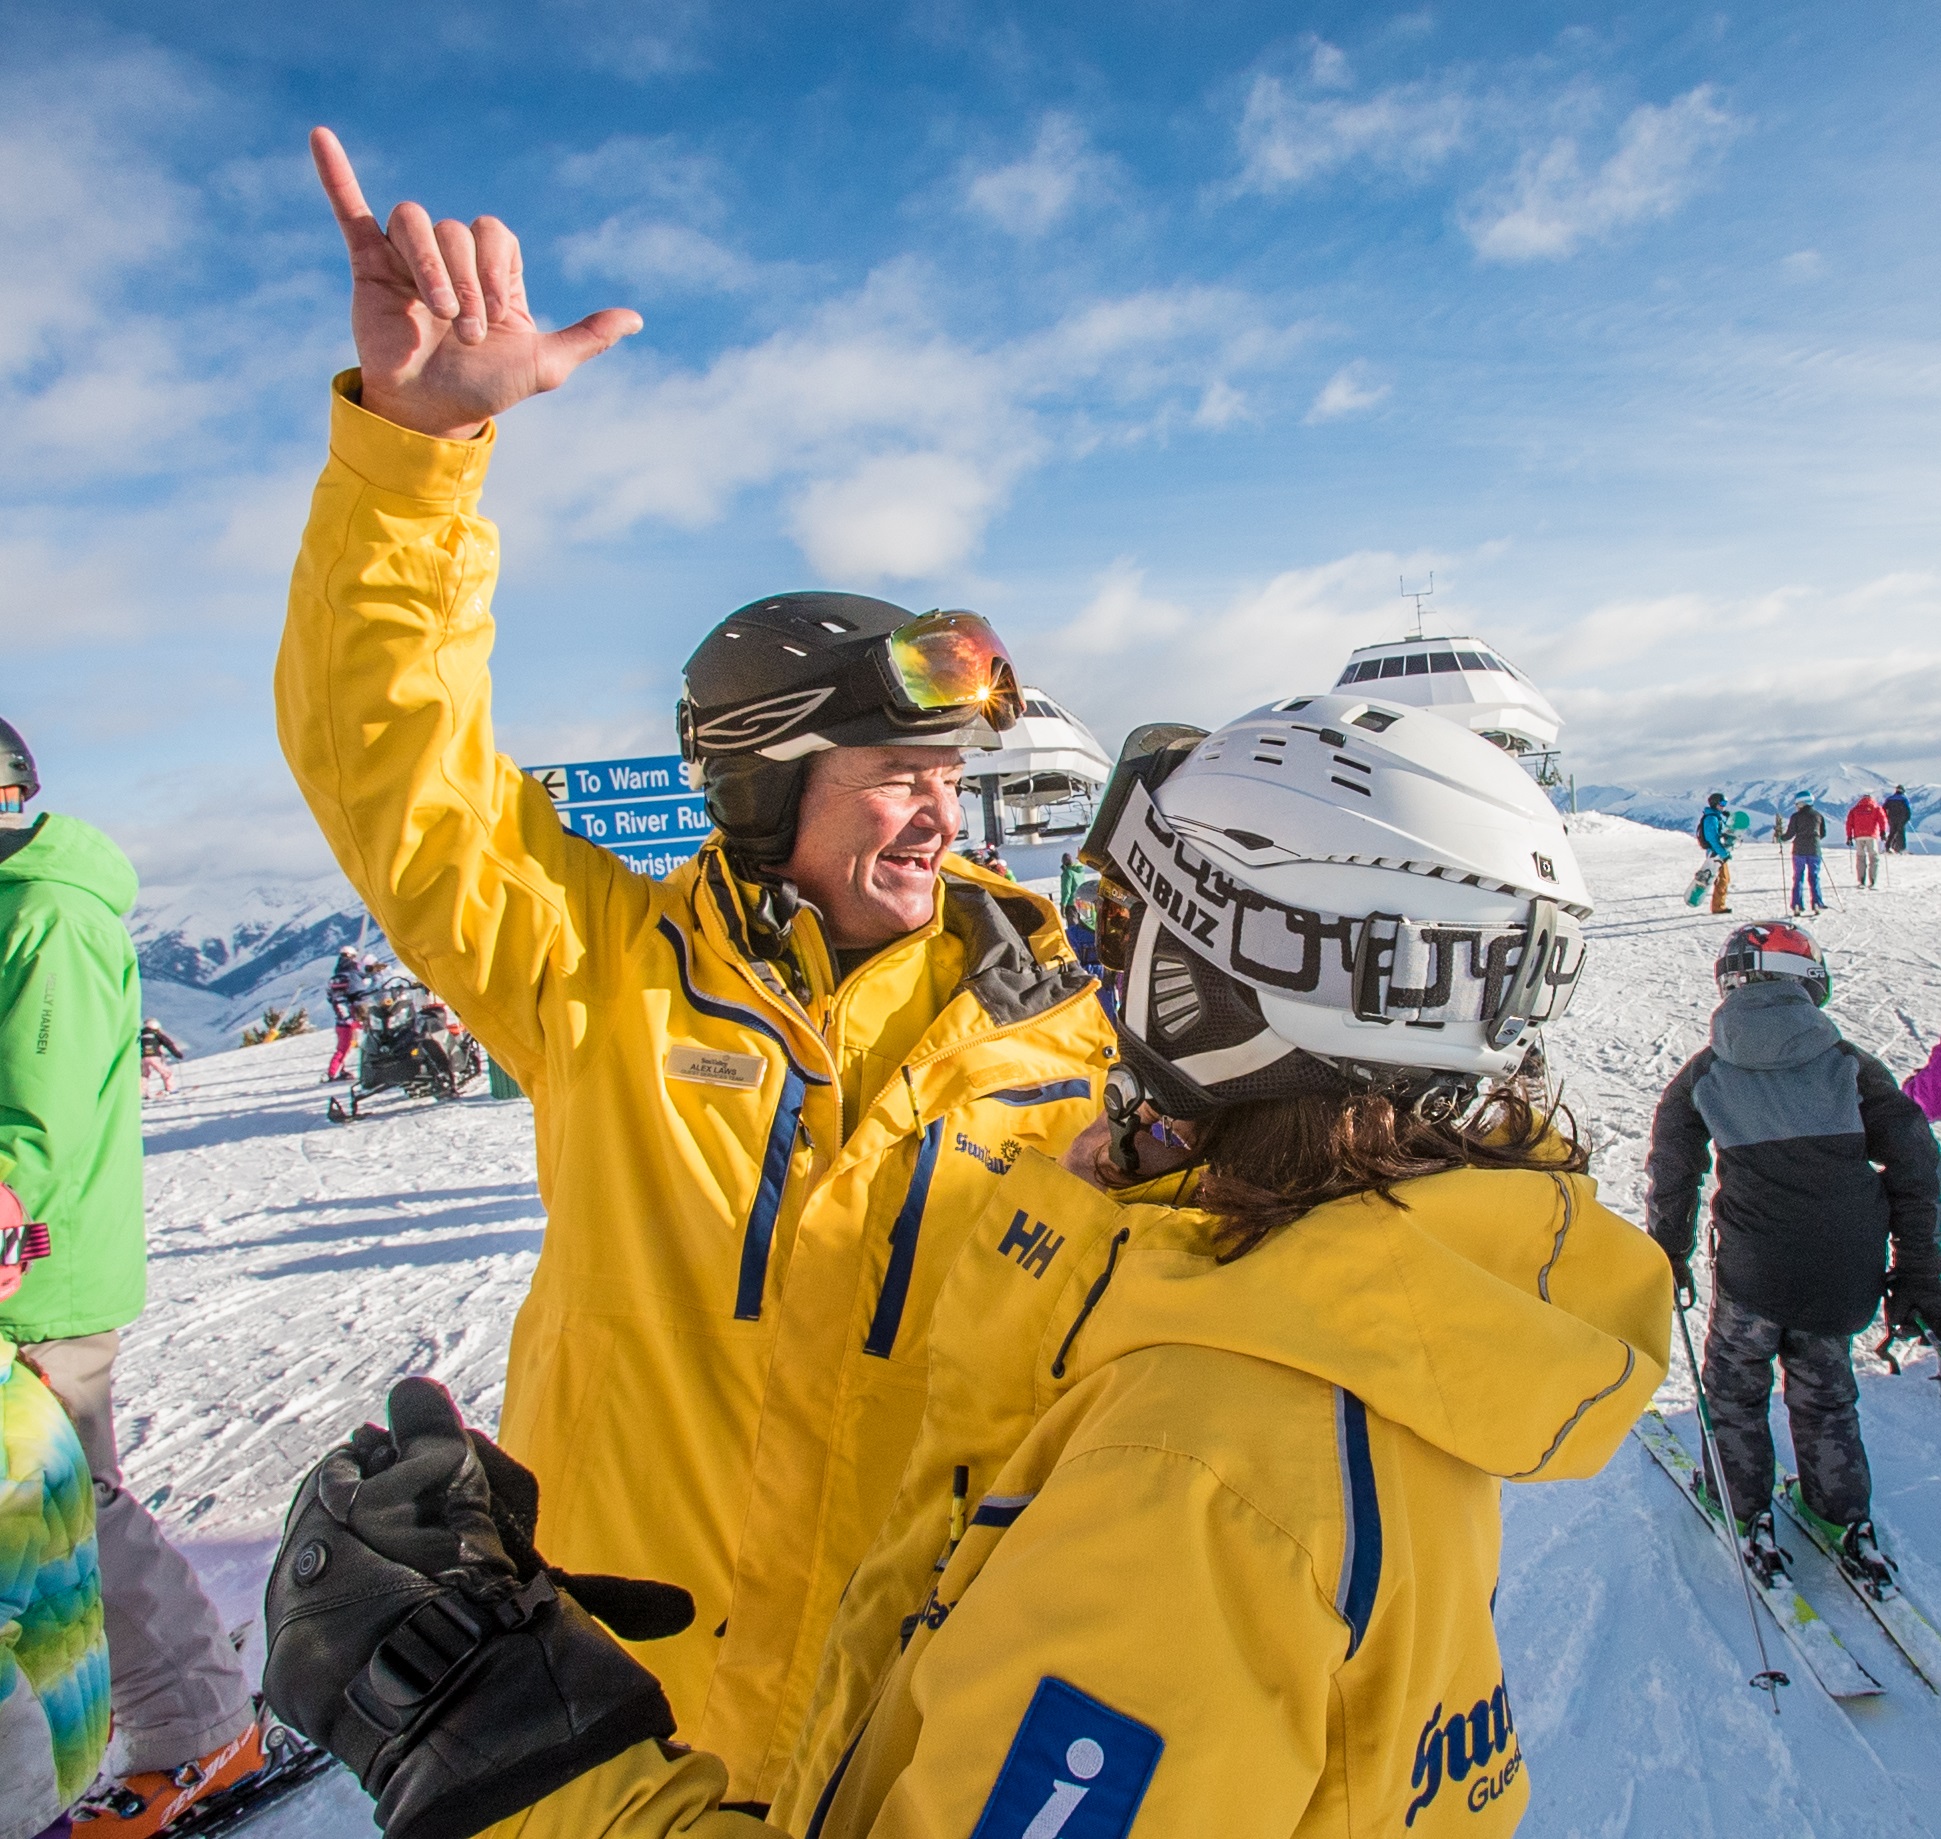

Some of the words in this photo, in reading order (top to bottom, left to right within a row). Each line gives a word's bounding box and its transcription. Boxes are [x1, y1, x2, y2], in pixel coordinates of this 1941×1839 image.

[575, 769, 601, 793] To
[609, 766, 669, 791] Warm
[580, 813, 607, 837] To
[614, 810, 668, 835] River
[1152, 872, 1220, 949] BLIZ
[44, 972, 57, 1006] HELLY
[36, 1009, 52, 1055] HANSEN
[690, 1063, 711, 1073] ALEX
[714, 1065, 737, 1076] LAWS
